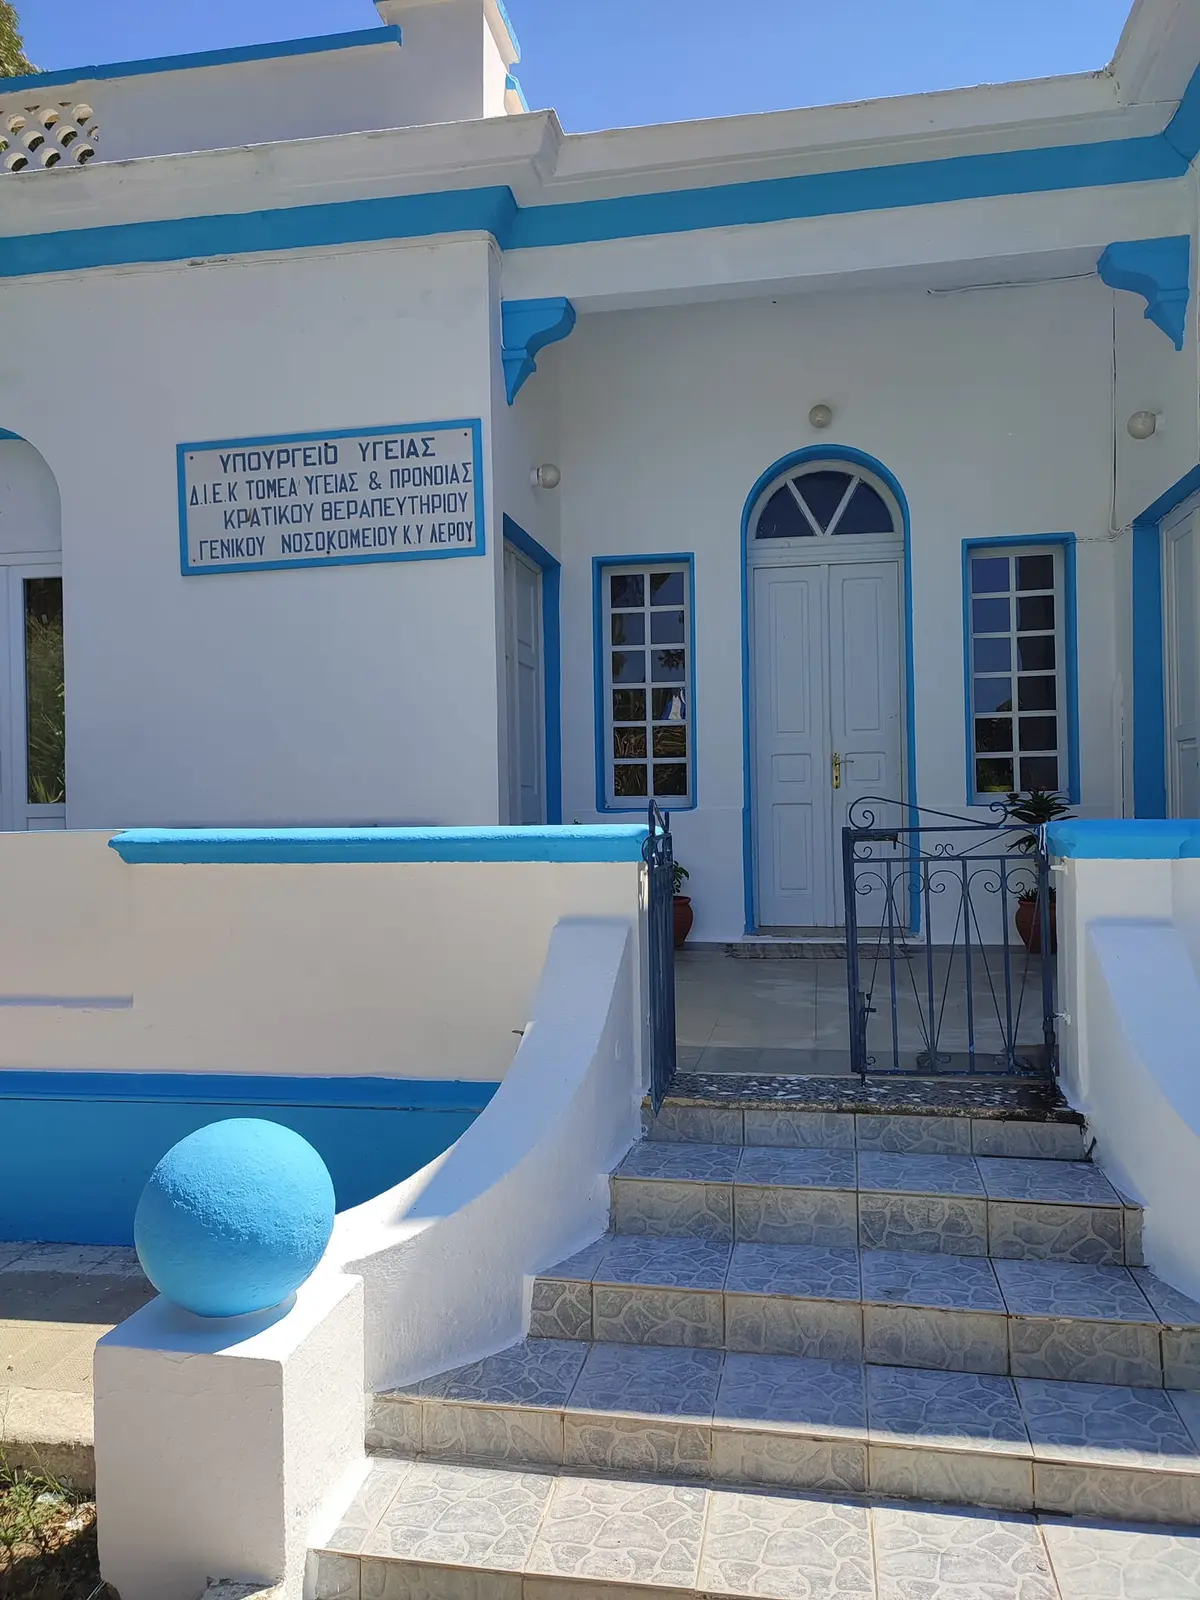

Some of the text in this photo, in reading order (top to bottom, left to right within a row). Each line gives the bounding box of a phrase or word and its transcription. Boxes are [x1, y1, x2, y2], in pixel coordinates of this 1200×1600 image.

[219, 437, 436, 473] ΥΠΟΥΡΓΕΙΟ ΥΓΕΙΑΣ
[246, 475, 299, 501] ΤΟΜΕΑ
[304, 472, 358, 496] ΥΓΕΙΑΣ
[369, 471, 382, 490] &
[390, 462, 472, 489] ΠΡΟΝΟΙΑΣ
[224, 492, 469, 529] ΚΡΑΤΙΚΟΥ ΘΕΡΑΠΕΥΤΗΡΙΟΥ
[199, 536, 266, 560] ΓΕΝΙΚΟΥ
[281, 526, 398, 554] ΝΟΣΟΚΟΜΕΙΟΥ
[430, 521, 474, 543] ΛΕΡΟΥ
